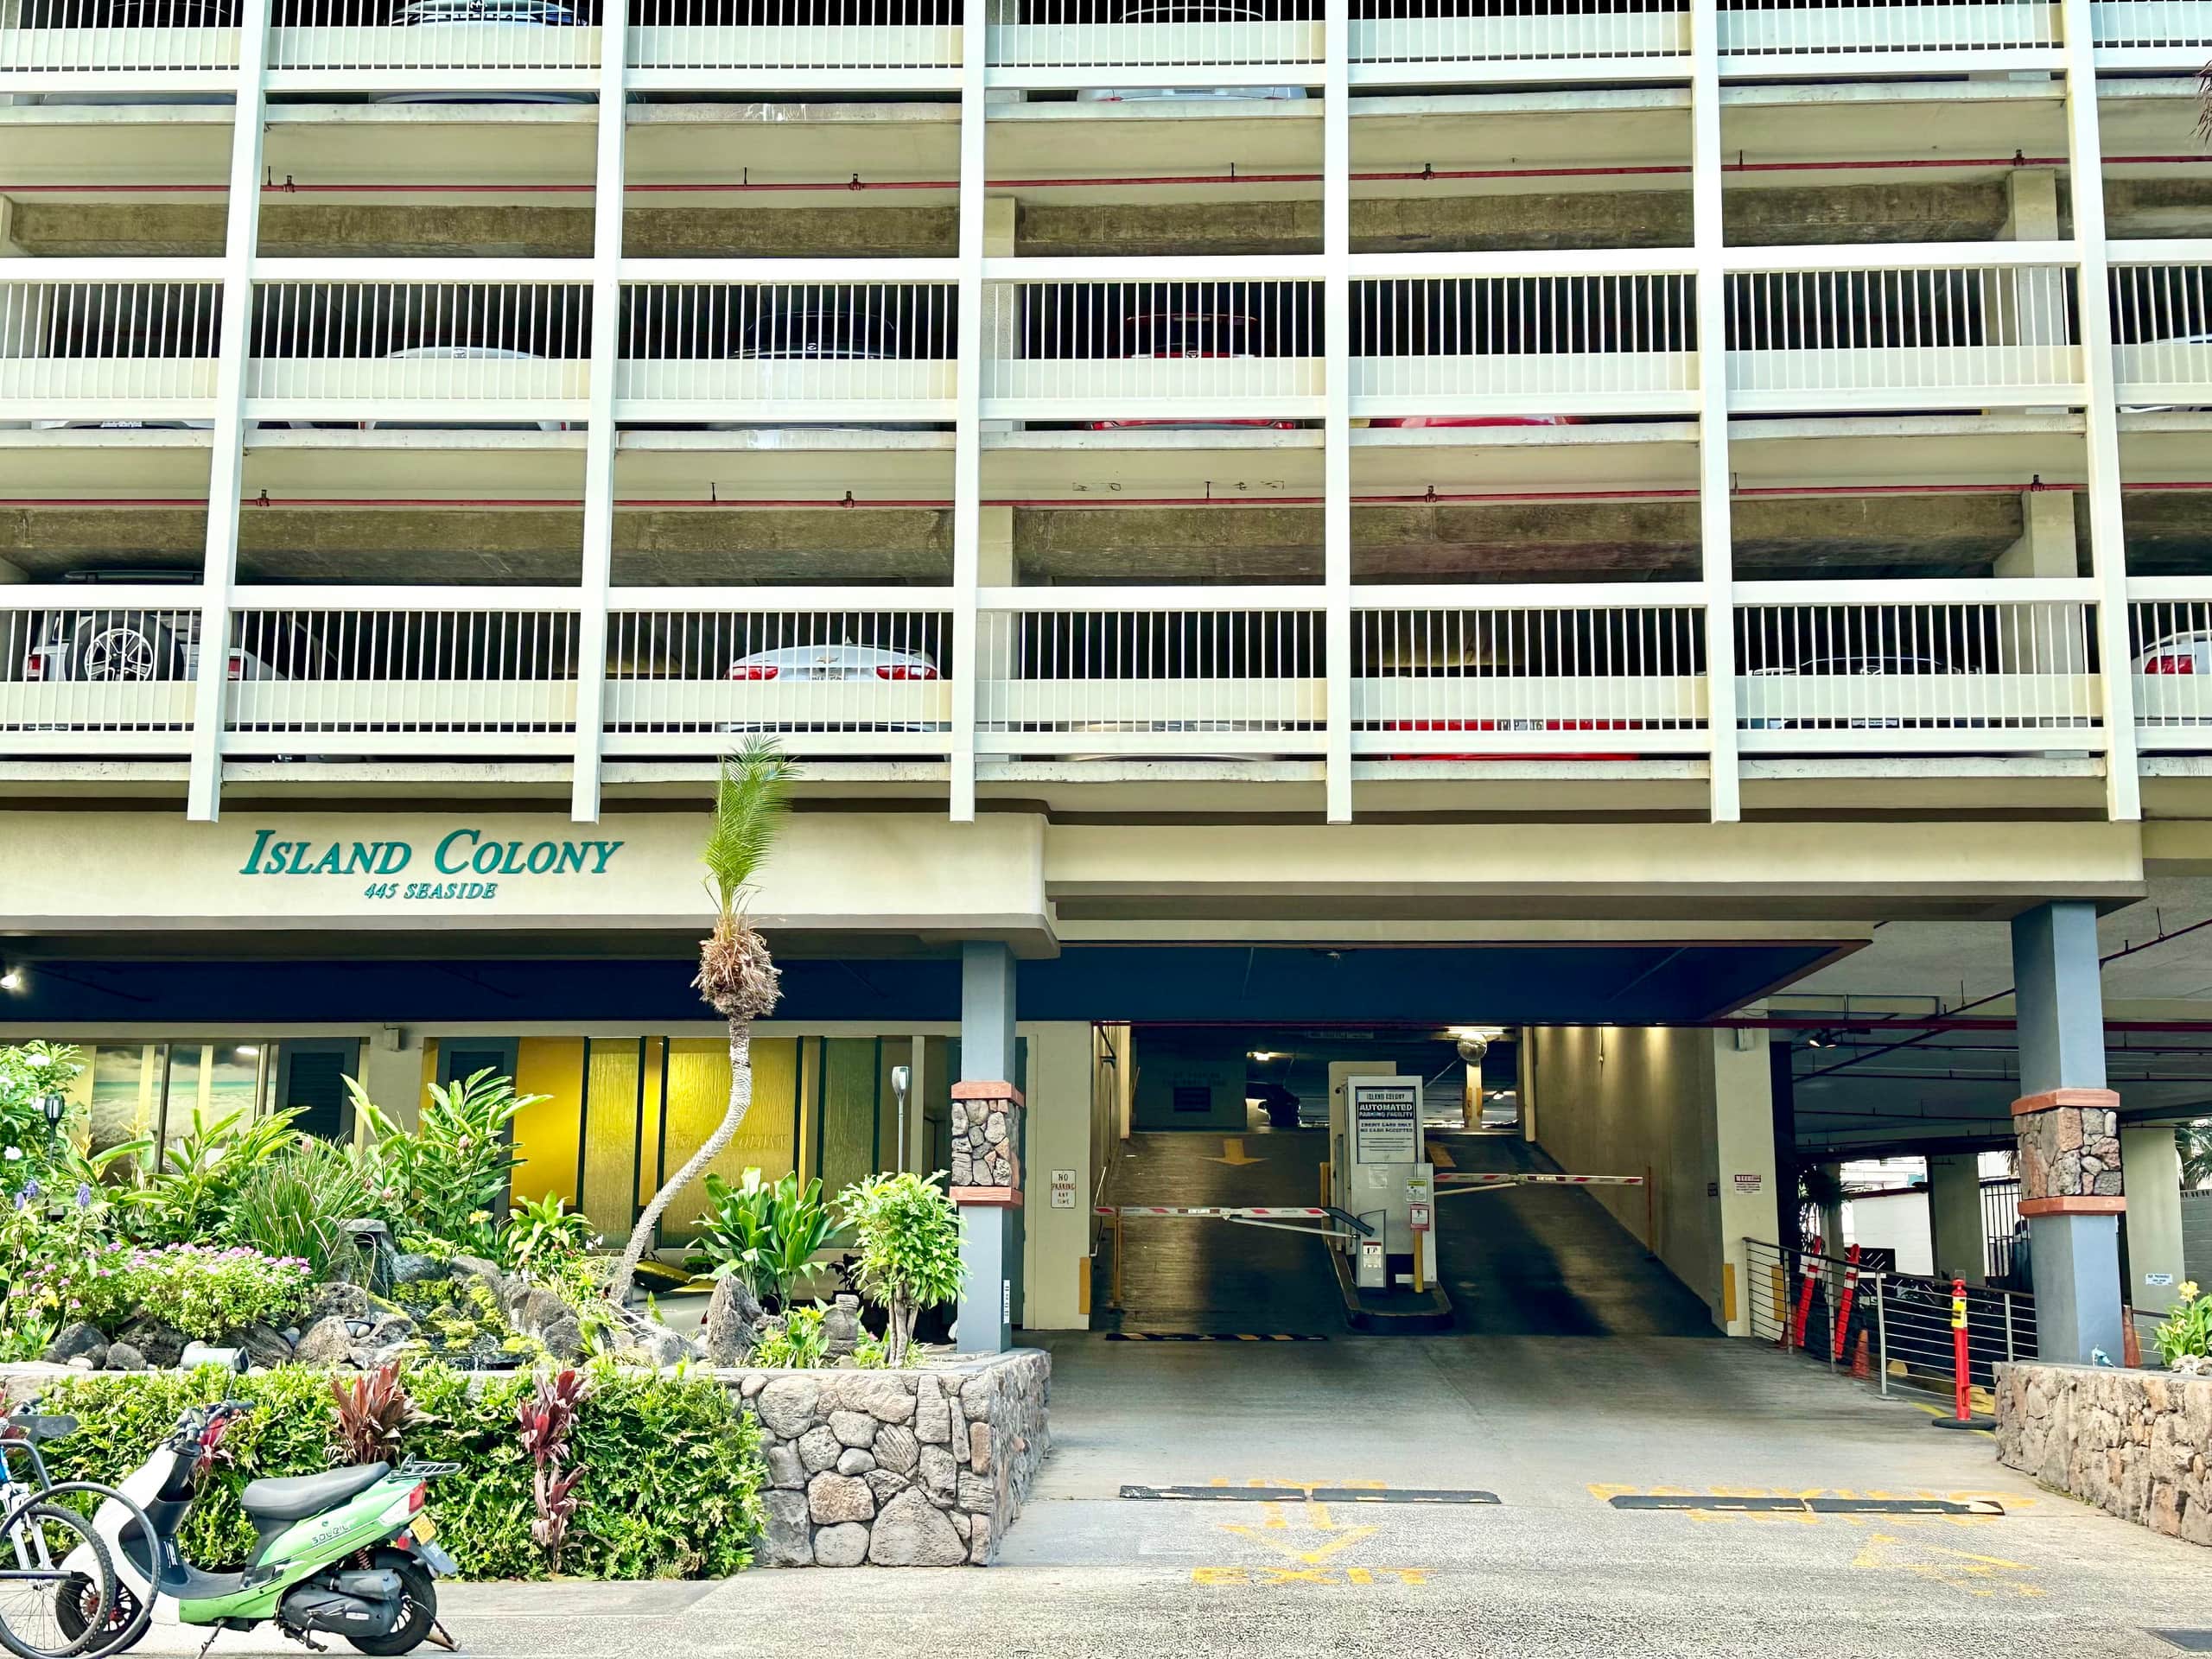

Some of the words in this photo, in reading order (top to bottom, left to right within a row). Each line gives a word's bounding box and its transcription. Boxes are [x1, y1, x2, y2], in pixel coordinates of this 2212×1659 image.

[239, 829, 411, 875] ISLAND
[433, 829, 624, 875] COLONY
[363, 882, 398, 899] 445
[404, 882, 498, 899] SEASIDE
[1192, 1567, 1439, 1585] EXIT
